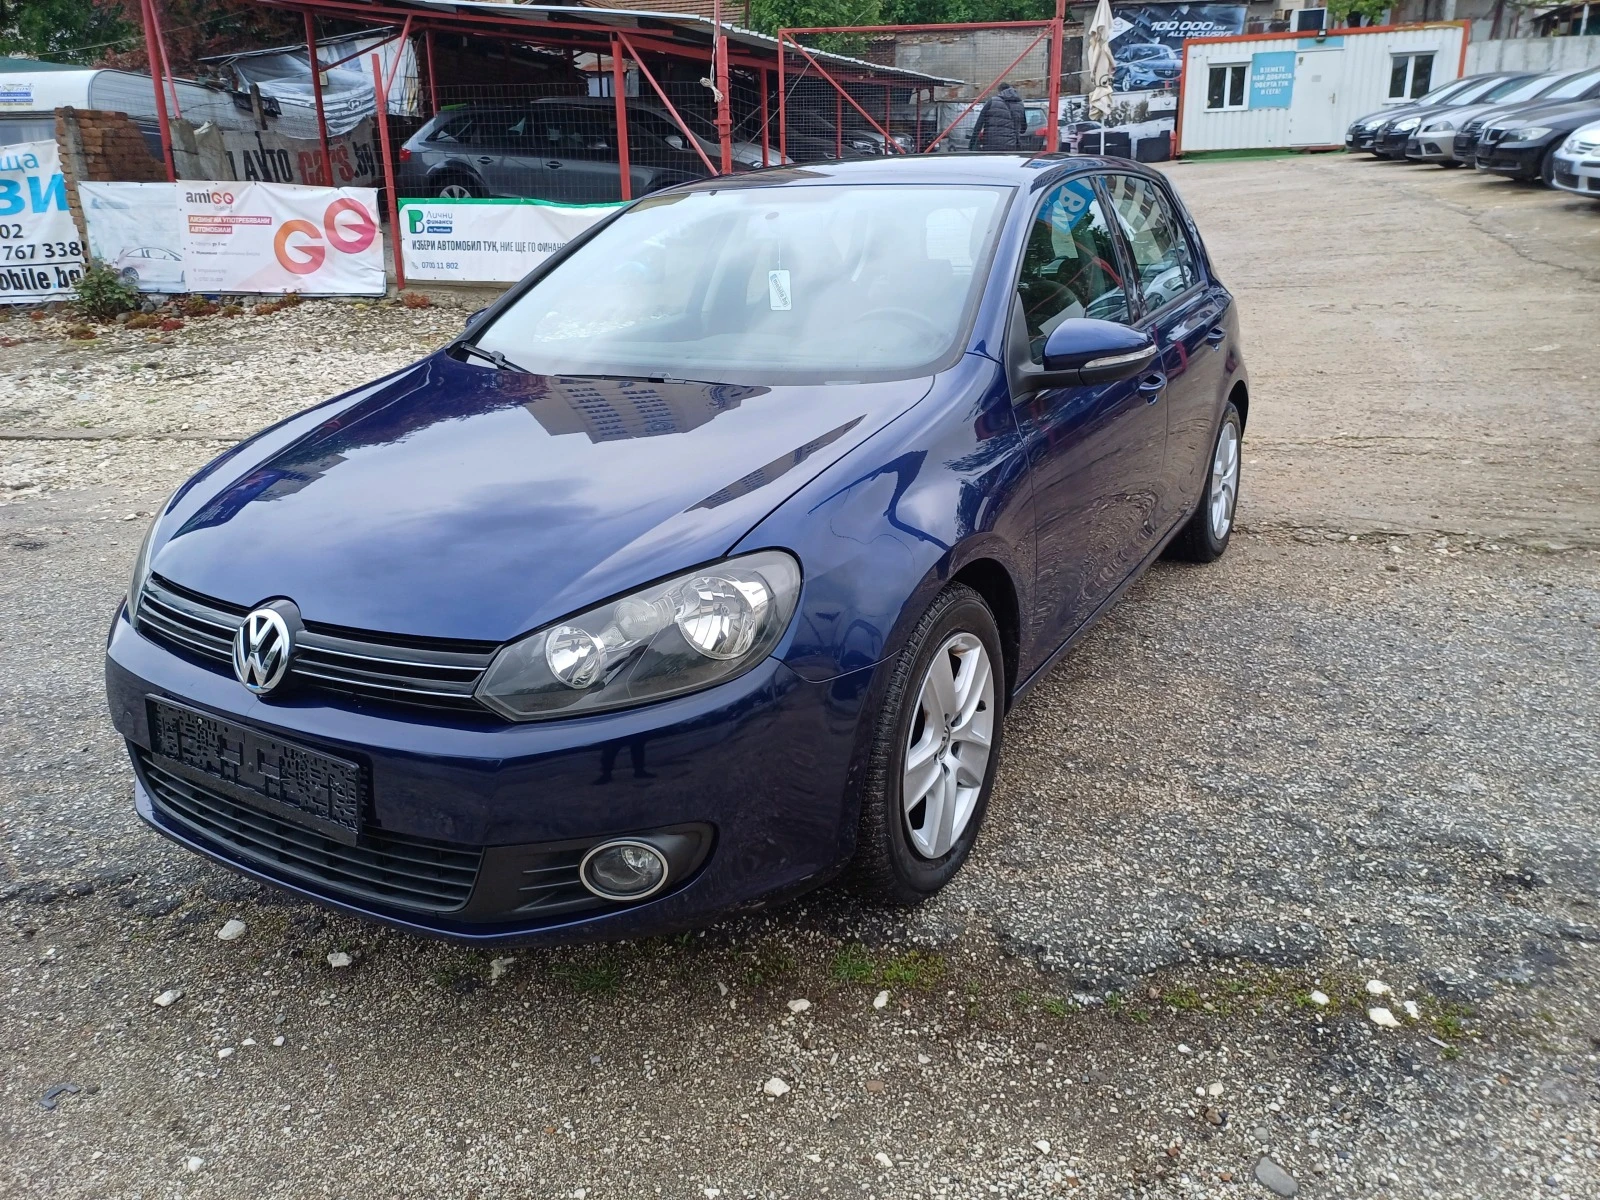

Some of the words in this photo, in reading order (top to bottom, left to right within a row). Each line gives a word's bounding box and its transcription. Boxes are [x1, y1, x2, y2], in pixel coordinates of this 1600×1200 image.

[1151, 21, 1179, 31] 100
[1179, 21, 1213, 31] 000
[426, 210, 453, 219] Лични
[3, 244, 36, 260] 767
[42, 241, 82, 258] 338
[412, 240, 436, 251] ИЗБЕРИ
[437, 240, 481, 251] АВТОМОБИЛ
[483, 241, 498, 253] ТУК,
[500, 241, 513, 252] НИЕ
[515, 241, 526, 253] ЩЕ
[528, 242, 536, 252] ГО
